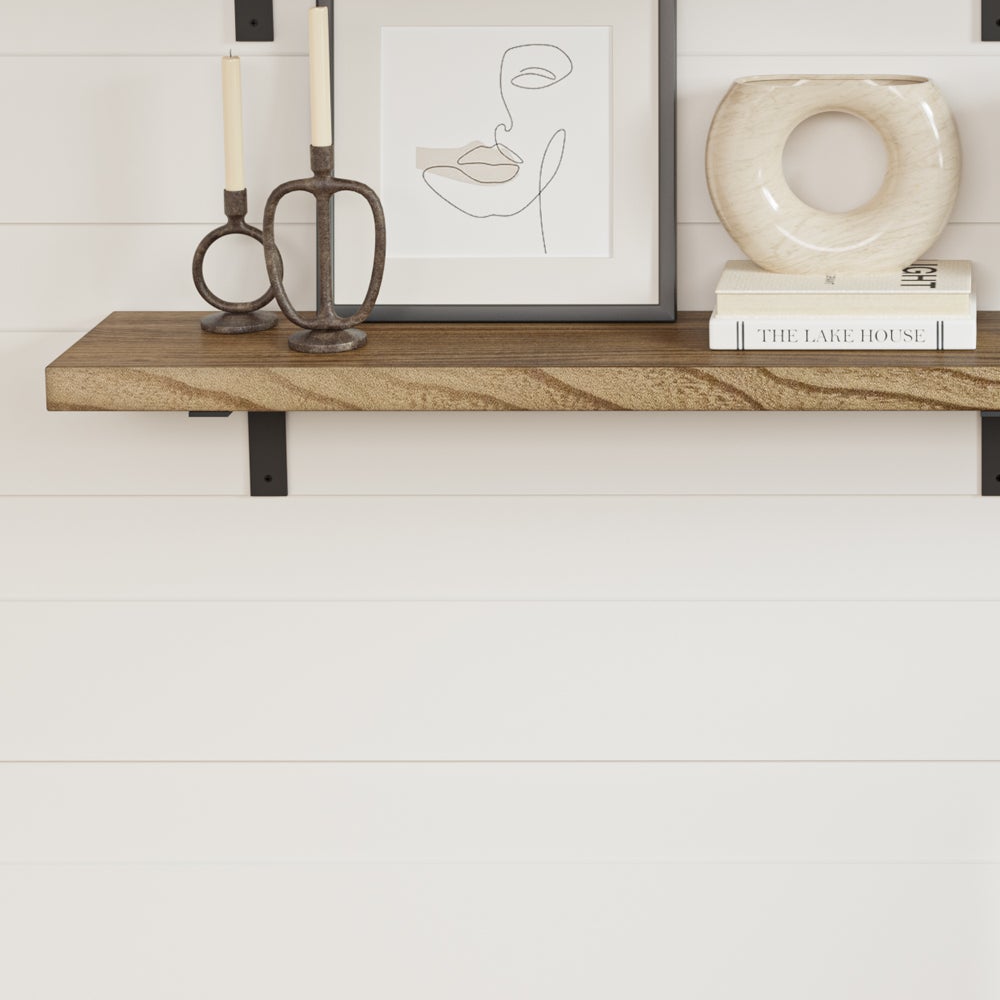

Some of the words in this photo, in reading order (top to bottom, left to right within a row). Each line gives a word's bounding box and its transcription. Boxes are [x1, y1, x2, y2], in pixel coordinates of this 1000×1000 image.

[757, 328, 798, 343] THE
[804, 328, 855, 343] LAKE
[860, 328, 926, 343] HOUSE
